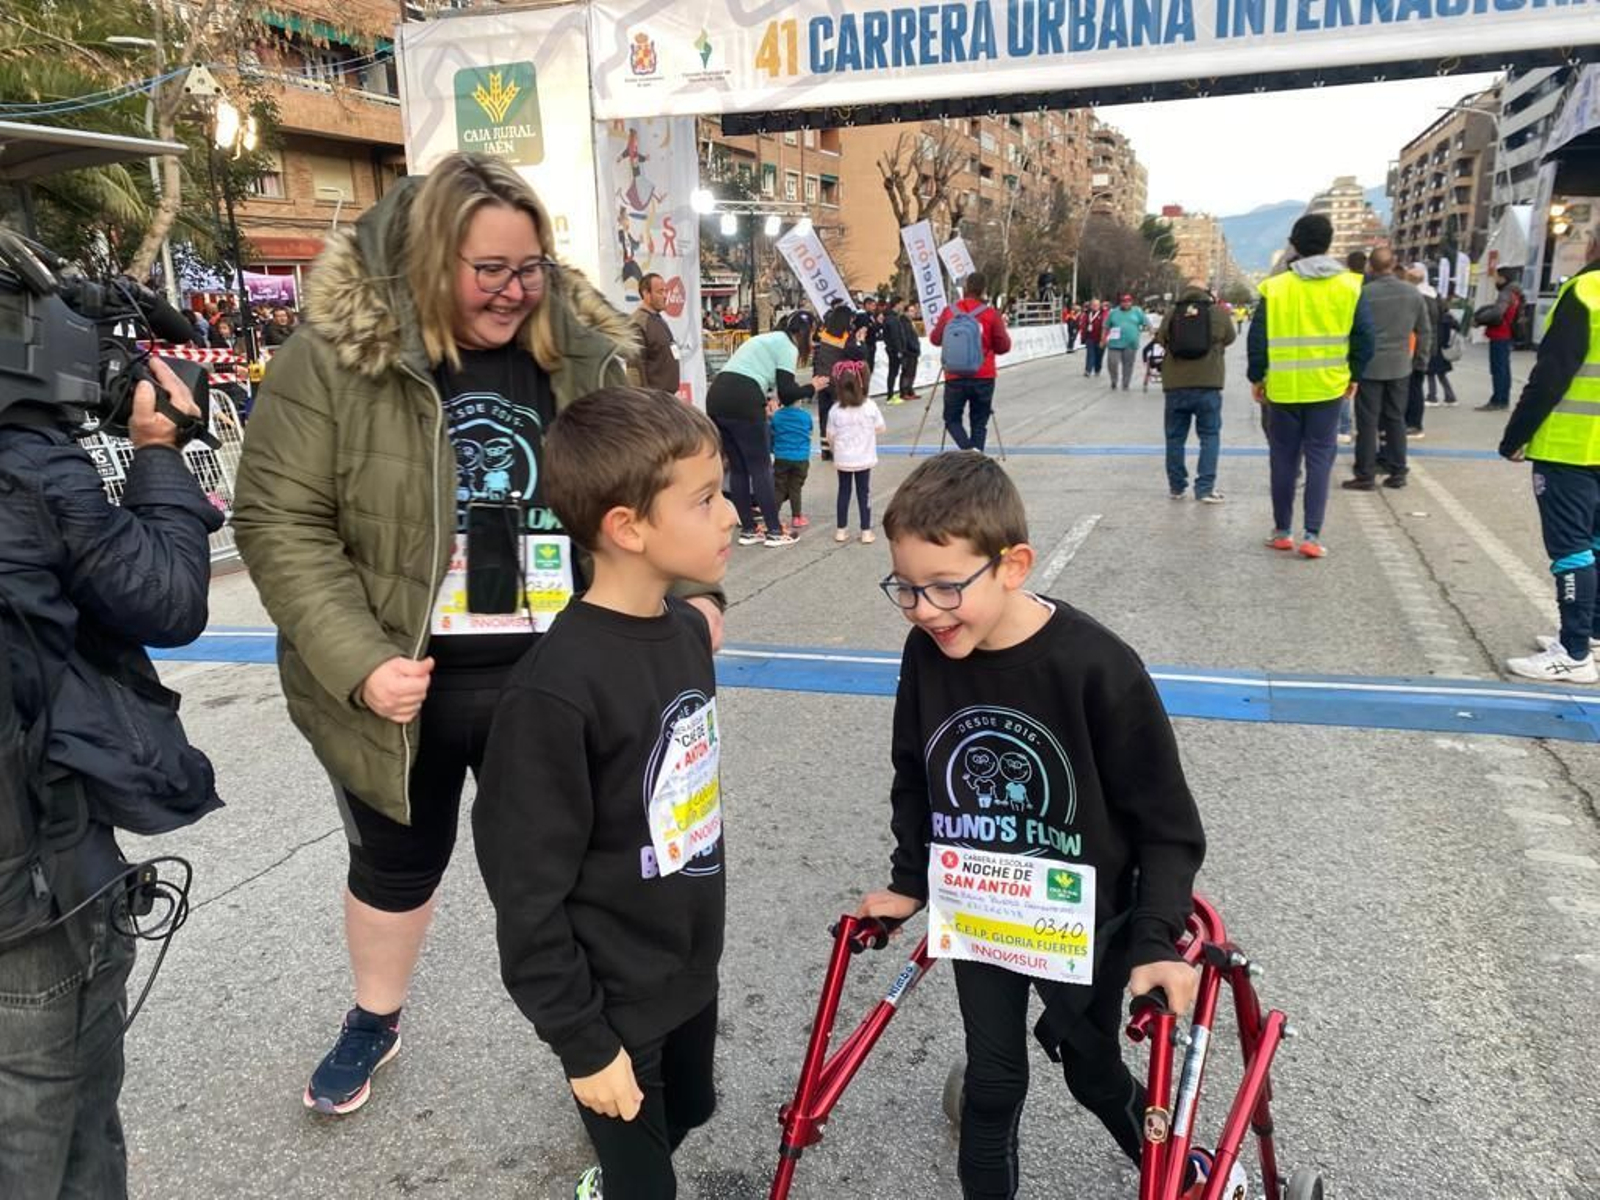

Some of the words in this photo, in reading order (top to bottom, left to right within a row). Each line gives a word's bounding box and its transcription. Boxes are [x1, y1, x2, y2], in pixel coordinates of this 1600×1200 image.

[755, 19, 798, 77] 41
[808, 0, 998, 74] CARRERA
[1007, 0, 1196, 57] URBANA
[492, 124, 537, 140] RURAL
[1025, 818, 1082, 857] FLOW
[962, 861, 1011, 879] NOCHE
[1013, 868, 1033, 882] DE
[943, 873, 974, 890] SAN
[977, 877, 1032, 898] ANTÓN
[971, 943, 1048, 971] INNOVASUR
[991, 930, 1034, 950] GLORIA
[1036, 939, 1088, 957] FUERTES
[887, 966, 914, 998] Nimbo
